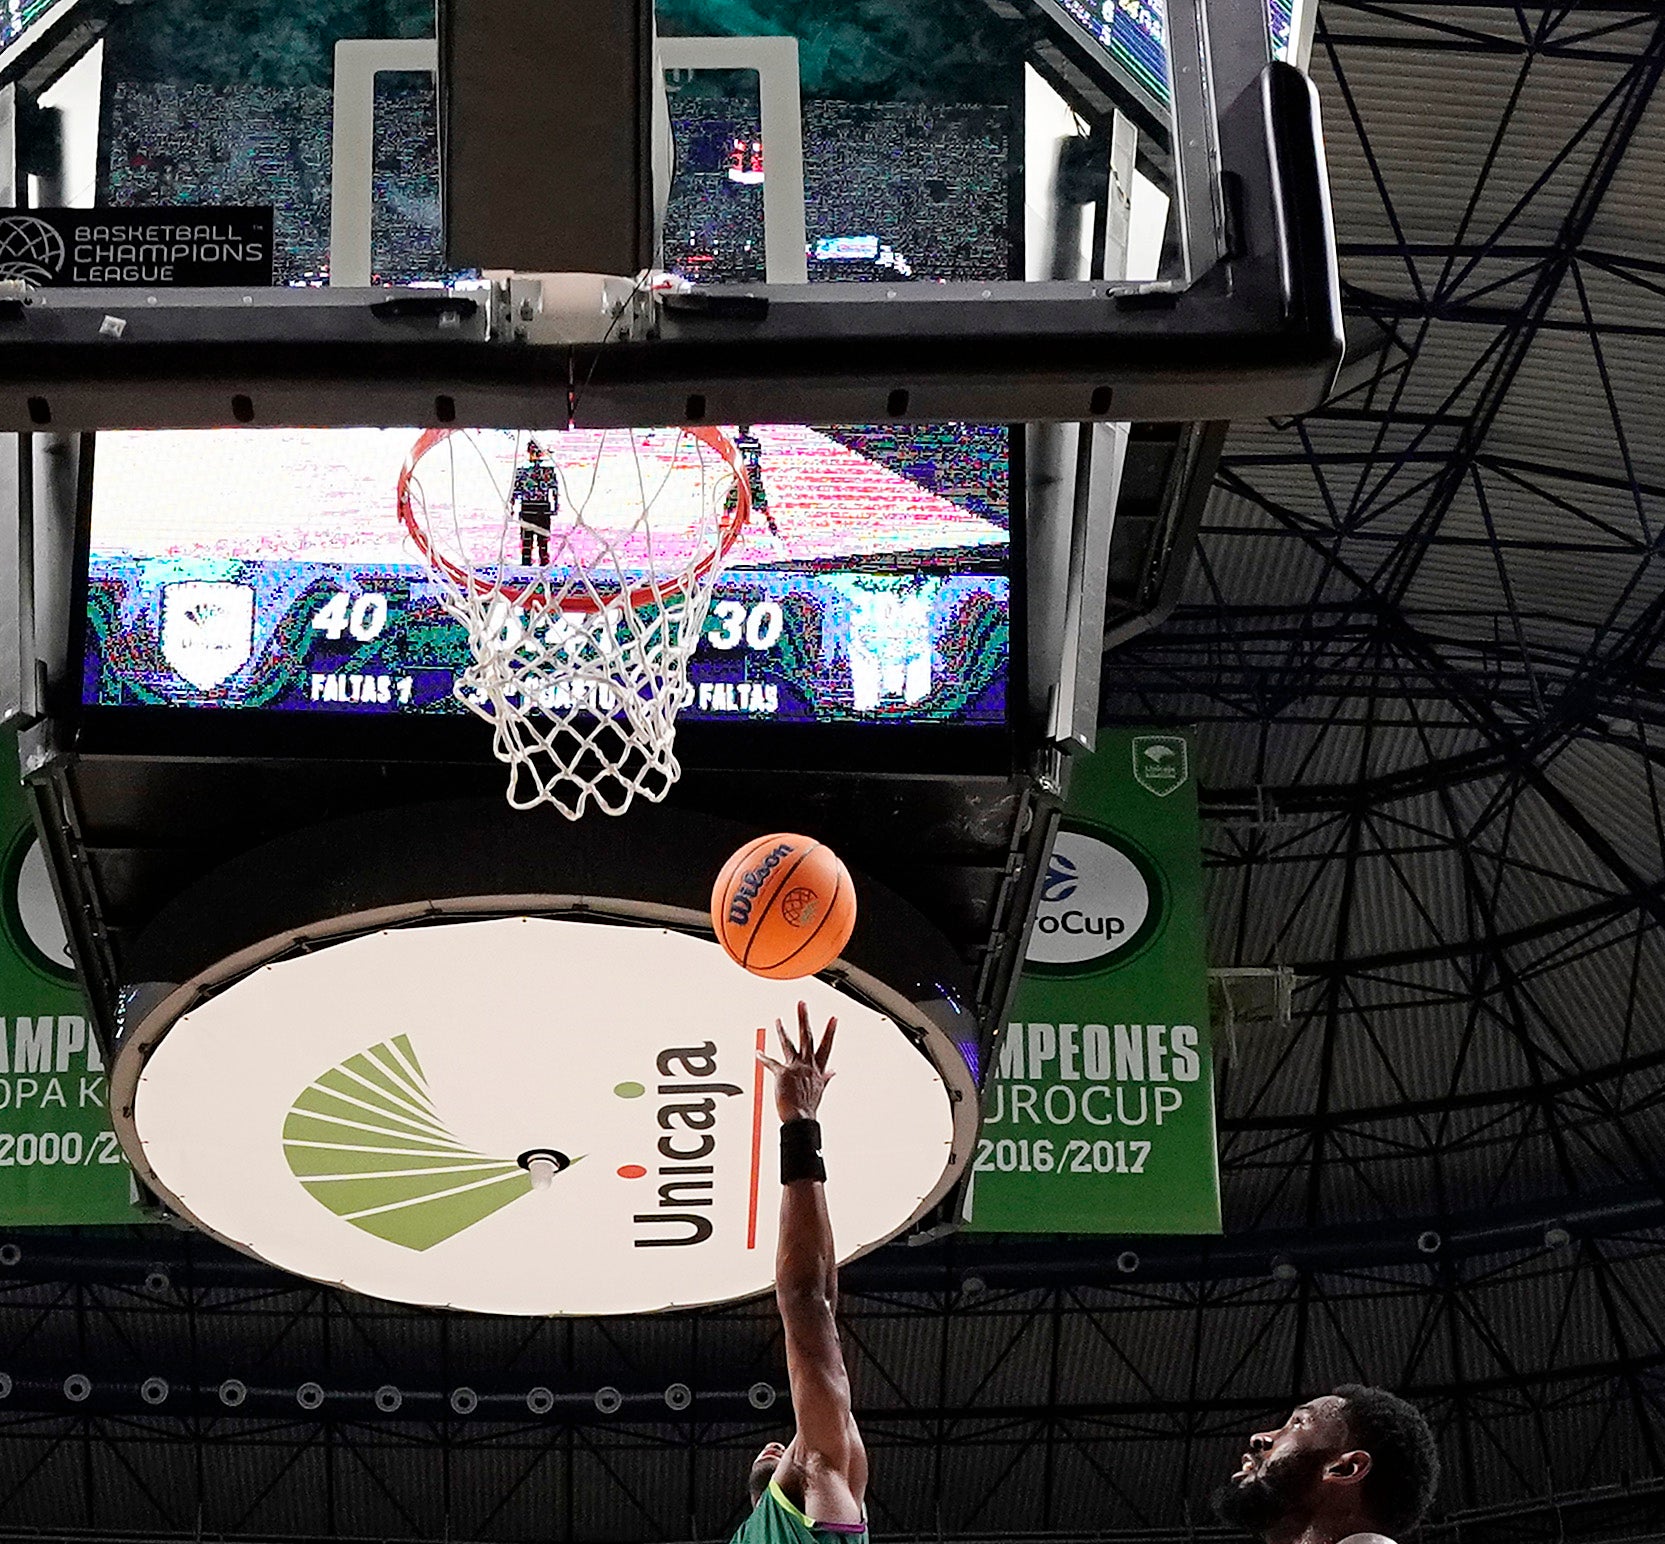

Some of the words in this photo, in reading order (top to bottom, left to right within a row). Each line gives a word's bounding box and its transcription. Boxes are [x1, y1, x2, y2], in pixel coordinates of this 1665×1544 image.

[75, 225, 242, 241] BASKETBALL
[74, 244, 263, 262] CHAMPIONS
[73, 266, 174, 281] LEAGUE
[311, 593, 388, 642] 40
[707, 601, 783, 651] 30
[310, 674, 393, 703] FALTAS
[698, 682, 779, 711] FALTAS
[730, 842, 794, 926] Wilson
[1036, 911, 1125, 940] oCup
[995, 1023, 1199, 1081] MPEONES
[79, 1077, 109, 1107] K
[984, 1085, 1182, 1126] UROCUP
[613, 1040, 744, 1249] Unicaja
[973, 1139, 1151, 1173] 2016/2017
